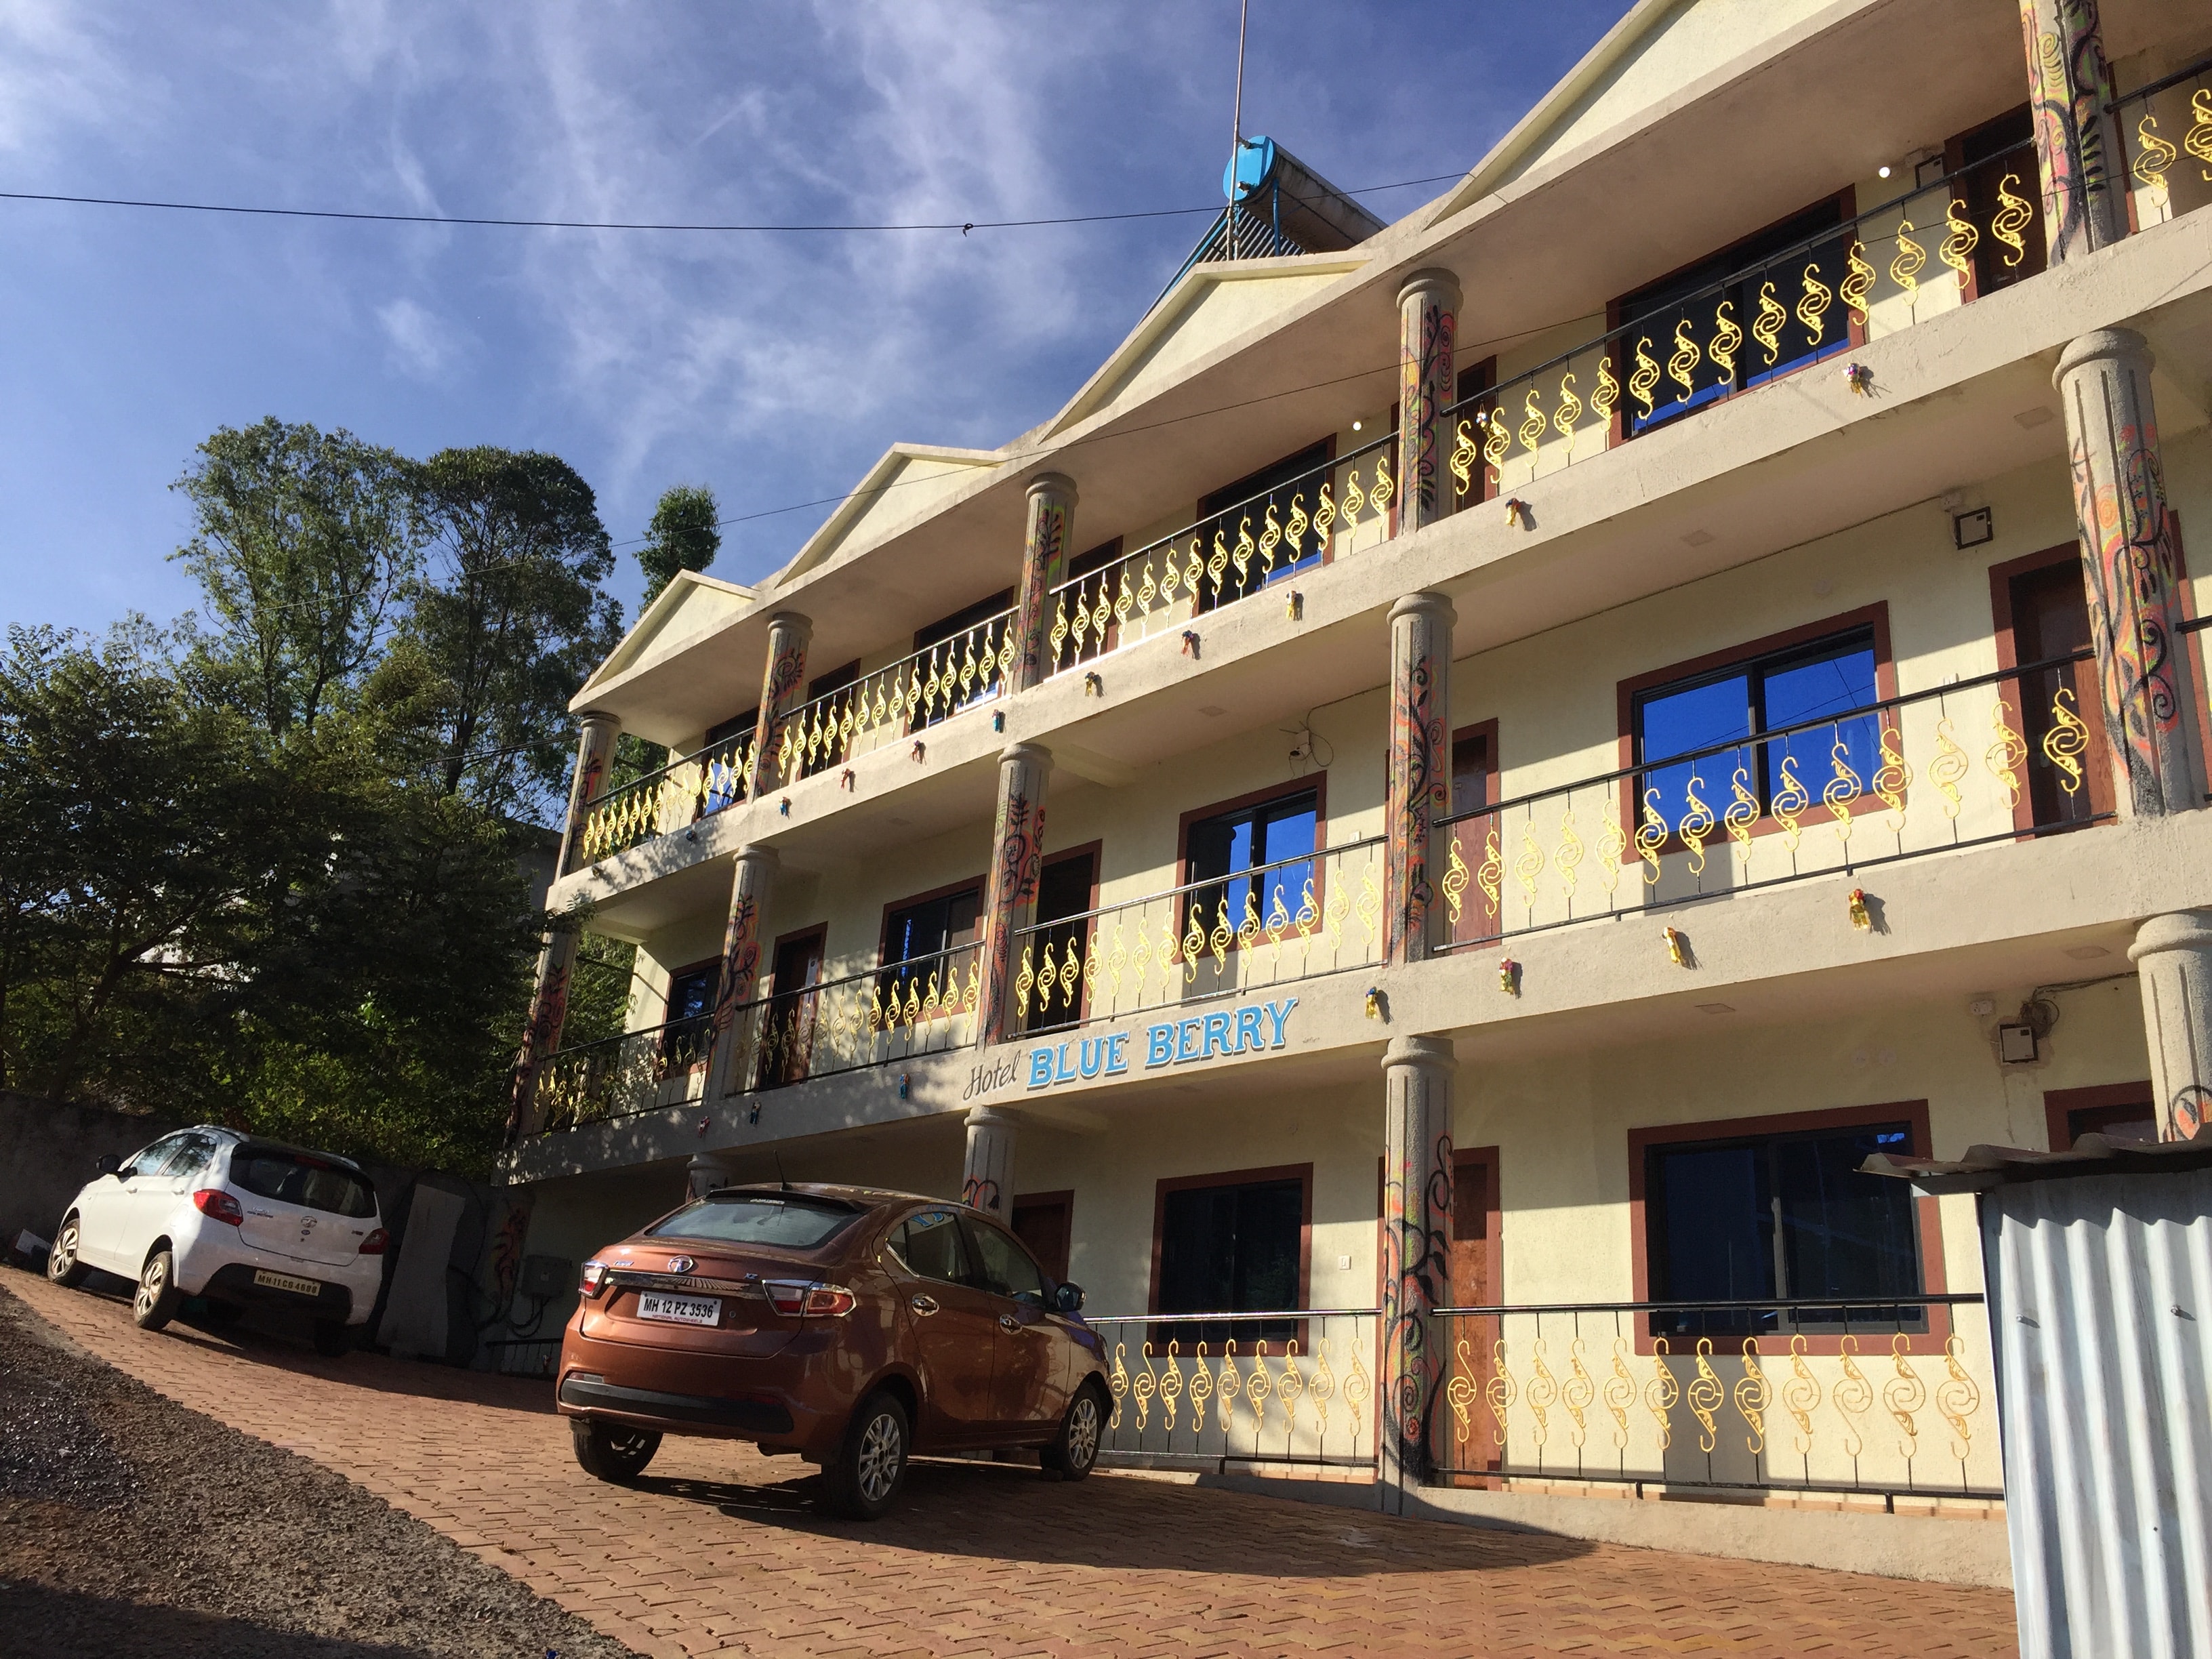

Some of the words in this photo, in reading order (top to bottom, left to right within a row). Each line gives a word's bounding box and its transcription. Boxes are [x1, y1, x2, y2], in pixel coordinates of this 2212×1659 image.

[963, 1050, 1021, 1101] Hotel
[1026, 1031, 1130, 1090] BLUE
[1145, 997, 1299, 1069] BERRY
[258, 1275, 272, 1284] MH
[273, 1277, 281, 1286] 11
[644, 1298, 659, 1312] MH
[662, 1300, 673, 1313] 12
[674, 1302, 688, 1315] PZ
[689, 1303, 714, 1318] 3536
